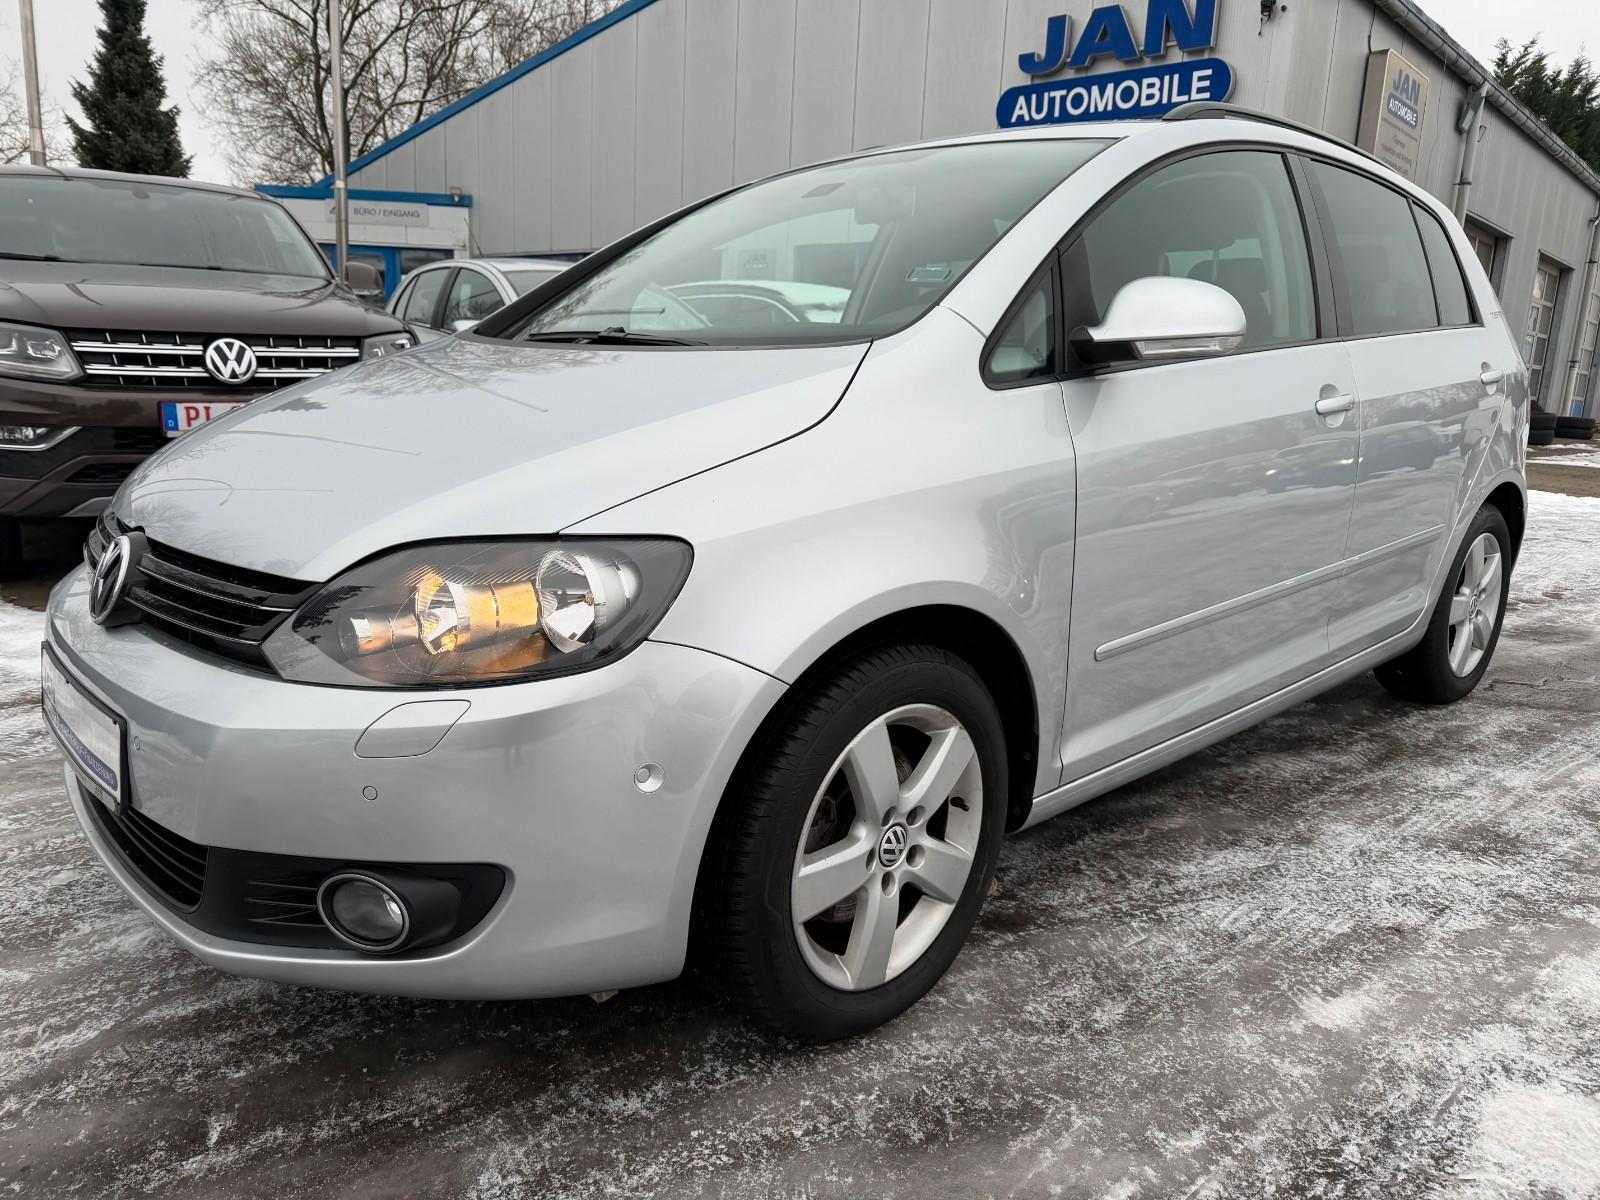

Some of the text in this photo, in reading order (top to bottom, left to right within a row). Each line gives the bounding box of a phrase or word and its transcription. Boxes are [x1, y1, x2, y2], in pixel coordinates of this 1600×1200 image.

[1018, 0, 1218, 75] JAN
[1010, 68, 1213, 123] AUTOMOBILE
[1392, 69, 1421, 106] JAN
[1388, 98, 1417, 126] AUTOMOBILE
[353, 206, 377, 216] BÜRO
[383, 209, 420, 218] EINGANG
[205, 338, 257, 384] VW
